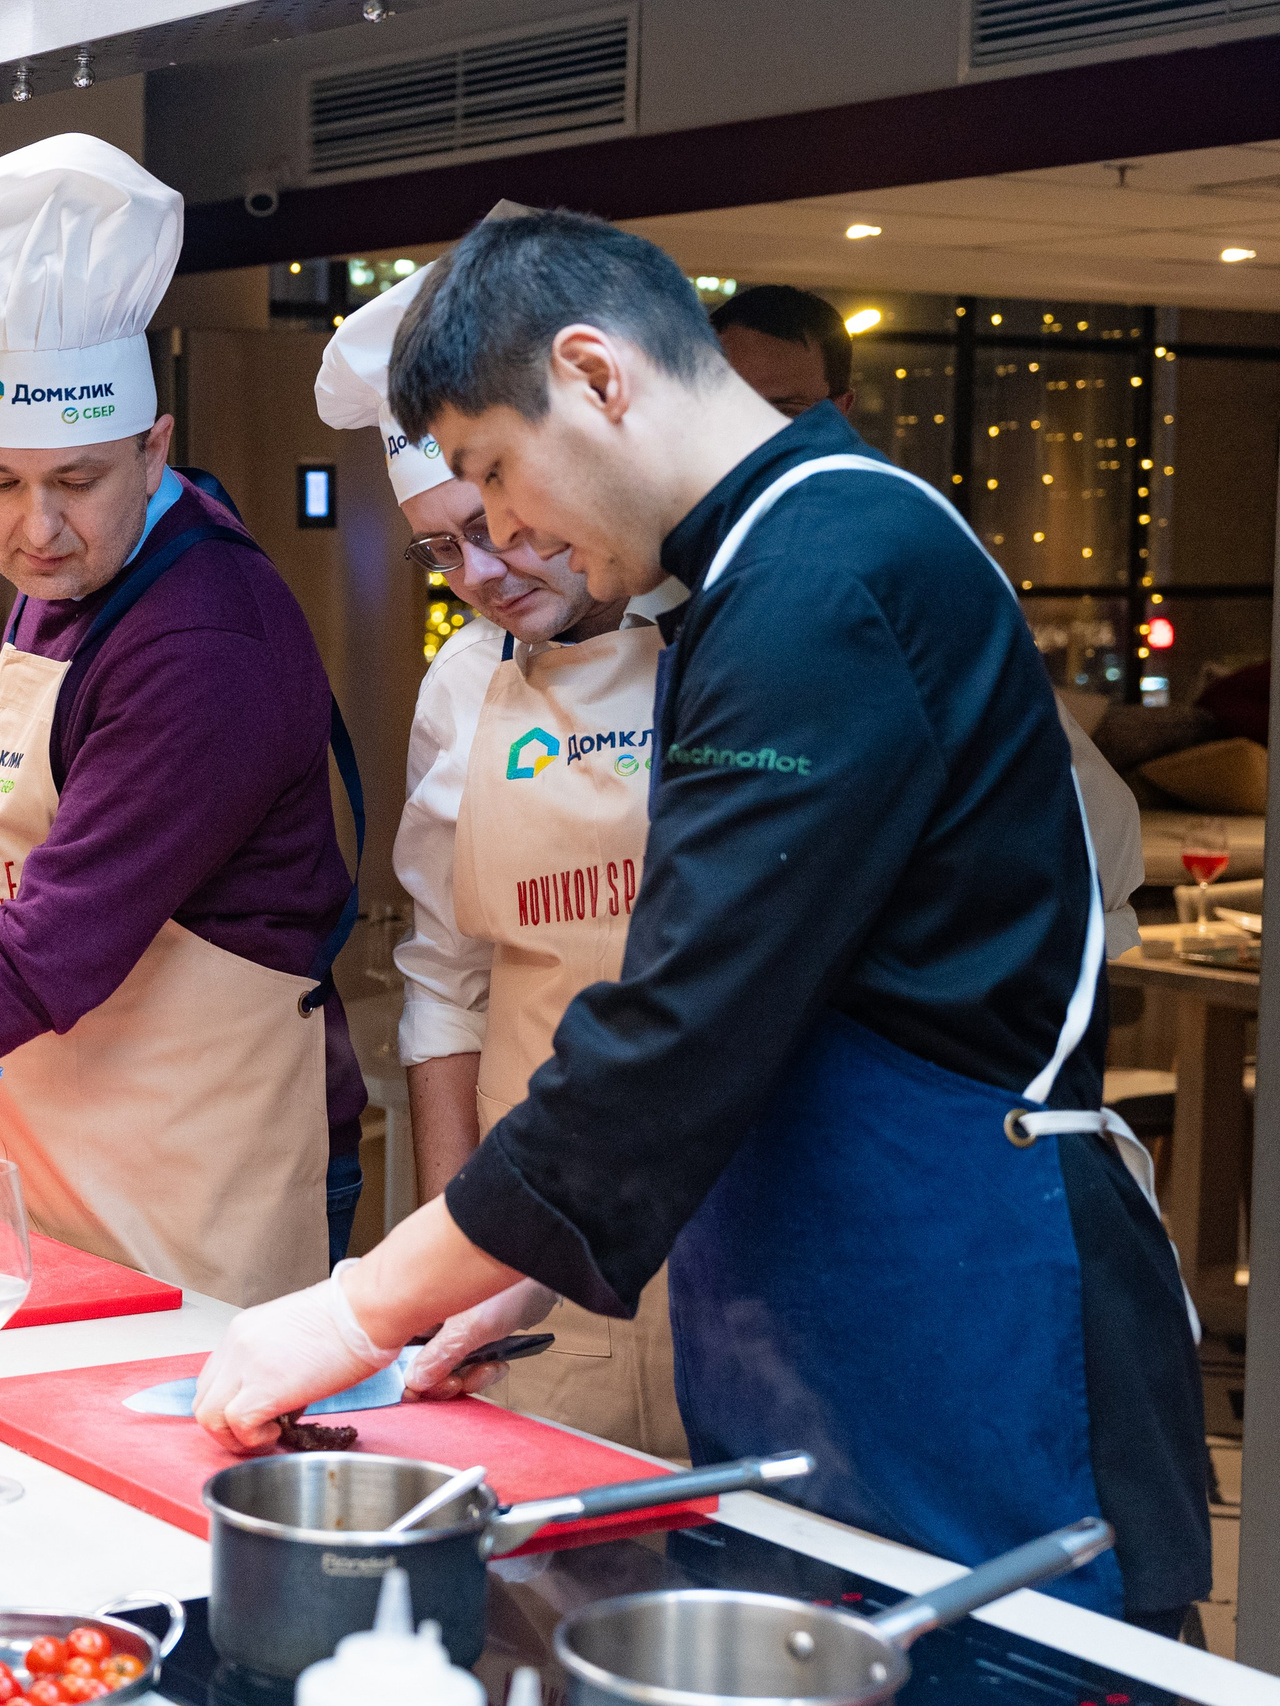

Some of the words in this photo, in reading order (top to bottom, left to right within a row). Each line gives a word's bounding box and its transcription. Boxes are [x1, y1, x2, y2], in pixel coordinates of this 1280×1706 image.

[11, 382, 115, 406] Домклик
[82, 404, 116, 420] СБЕР
[567, 729, 653, 766] Домкл
[517, 865, 599, 927] NOVIKOV
